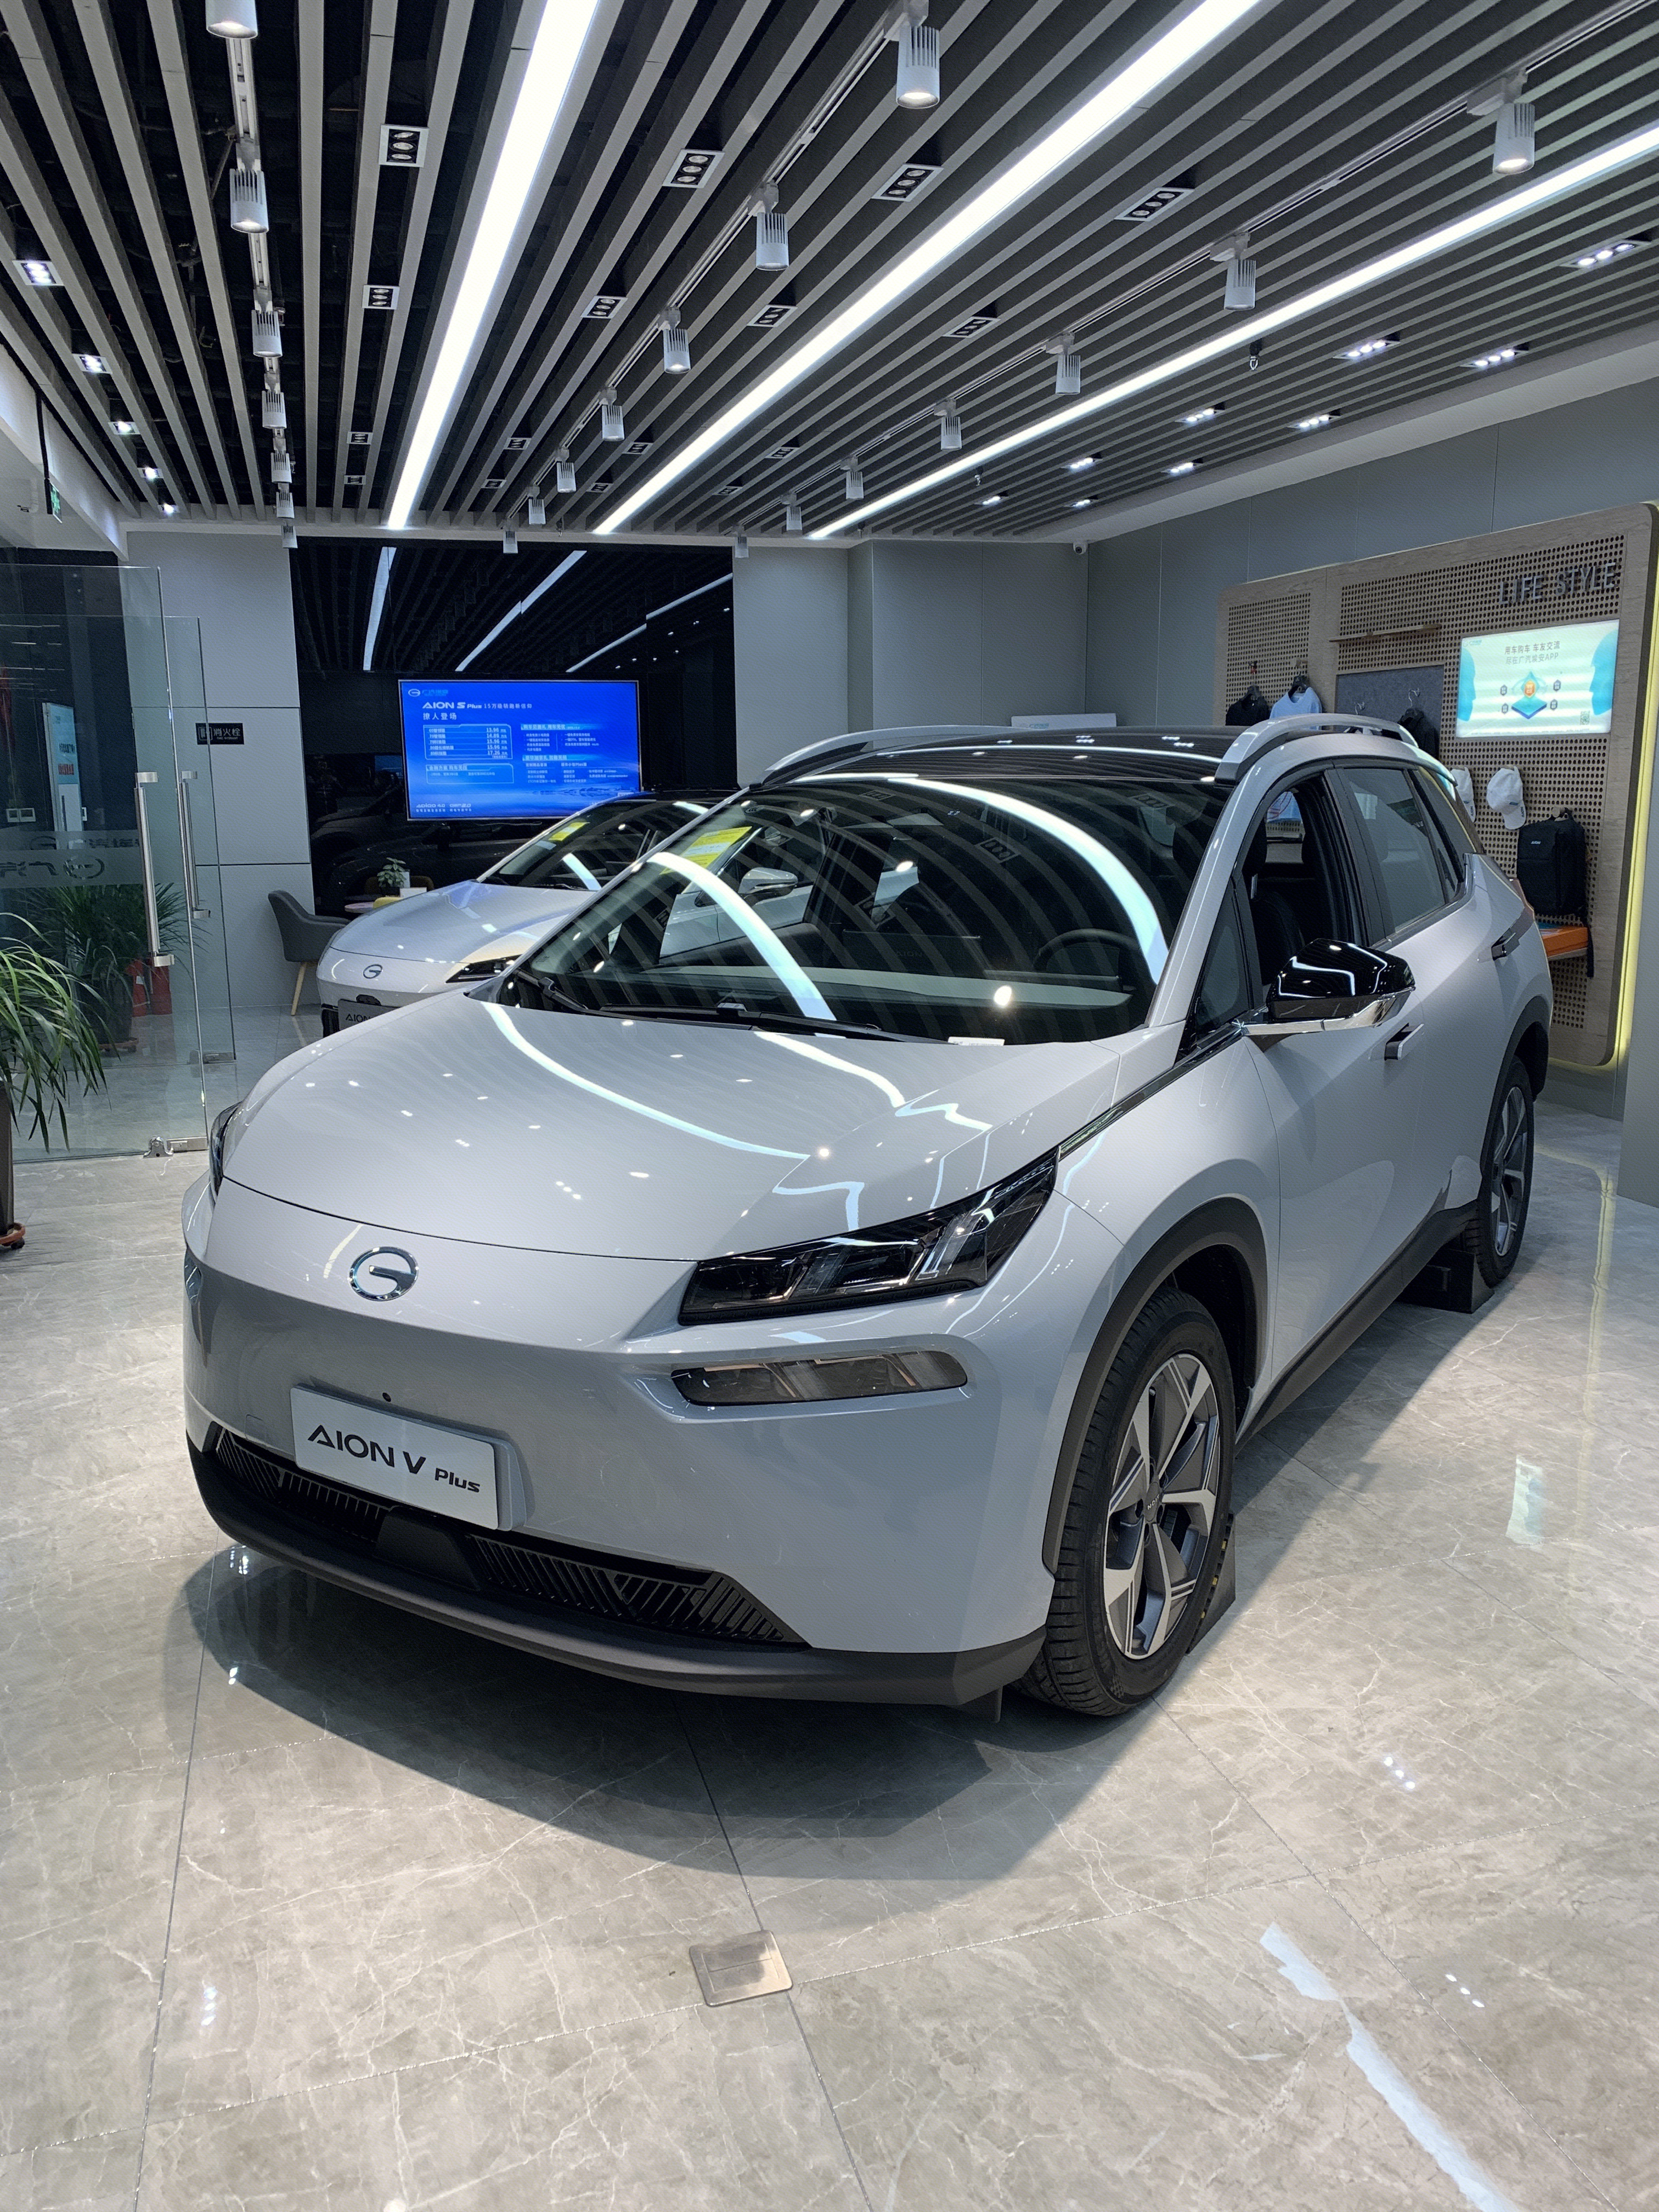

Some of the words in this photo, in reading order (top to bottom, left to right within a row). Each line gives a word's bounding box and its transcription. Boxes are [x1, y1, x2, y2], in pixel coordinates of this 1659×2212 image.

[1500, 575, 1543, 603] LIFE
[1555, 562, 1616, 596] STYLE
[1504, 644, 1530, 654] 用车购车
[1533, 641, 1560, 652] 车友交流
[213, 727, 241, 736] 消火栓
[307, 1424, 395, 1468] AION
[402, 1451, 426, 1474] V
[435, 1468, 481, 1493] Plus
